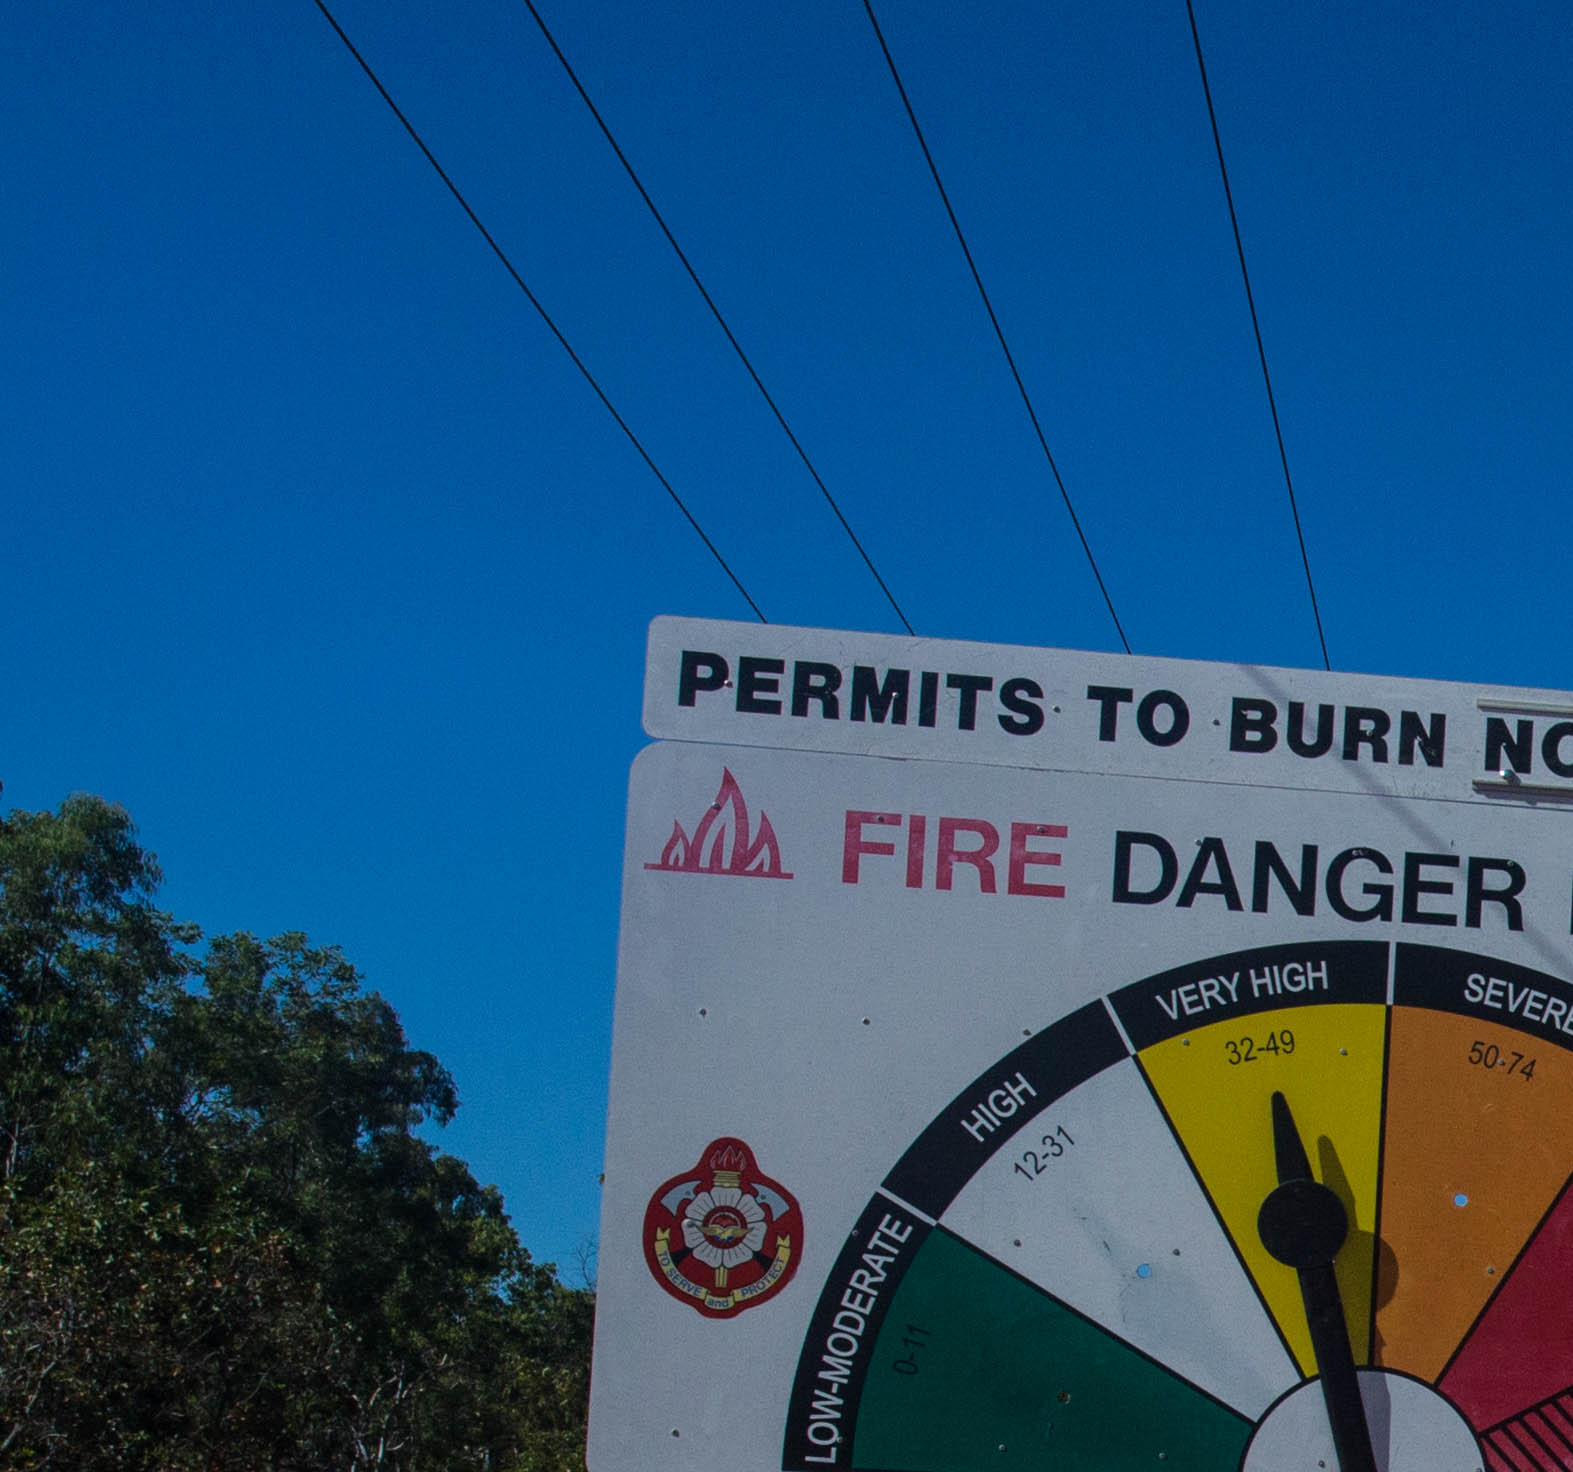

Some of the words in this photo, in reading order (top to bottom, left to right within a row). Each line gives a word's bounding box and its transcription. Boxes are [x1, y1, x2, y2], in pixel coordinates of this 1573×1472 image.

[678, 650, 1045, 736] PERMITS
[1087, 684, 1191, 747] TO
[1229, 696, 1446, 768] BURN
[842, 809, 1068, 898] FIRE
[1112, 830, 1527, 932] DANGER
[1155, 971, 1240, 1020] VERY
[1250, 960, 1329, 998] HIGH
[1225, 1029, 1295, 1065] 32-49
[1467, 1040, 1538, 1082] 50-74
[960, 1071, 1038, 1142] HIGH
[1014, 1124, 1075, 1181] 12-31
[668, 1268, 704, 1298] SERVE
[740, 1257, 786, 1298] PROTECT
[804, 1213, 914, 1465] LOW-MODERATE
[892, 1323, 932, 1376] 0-11
